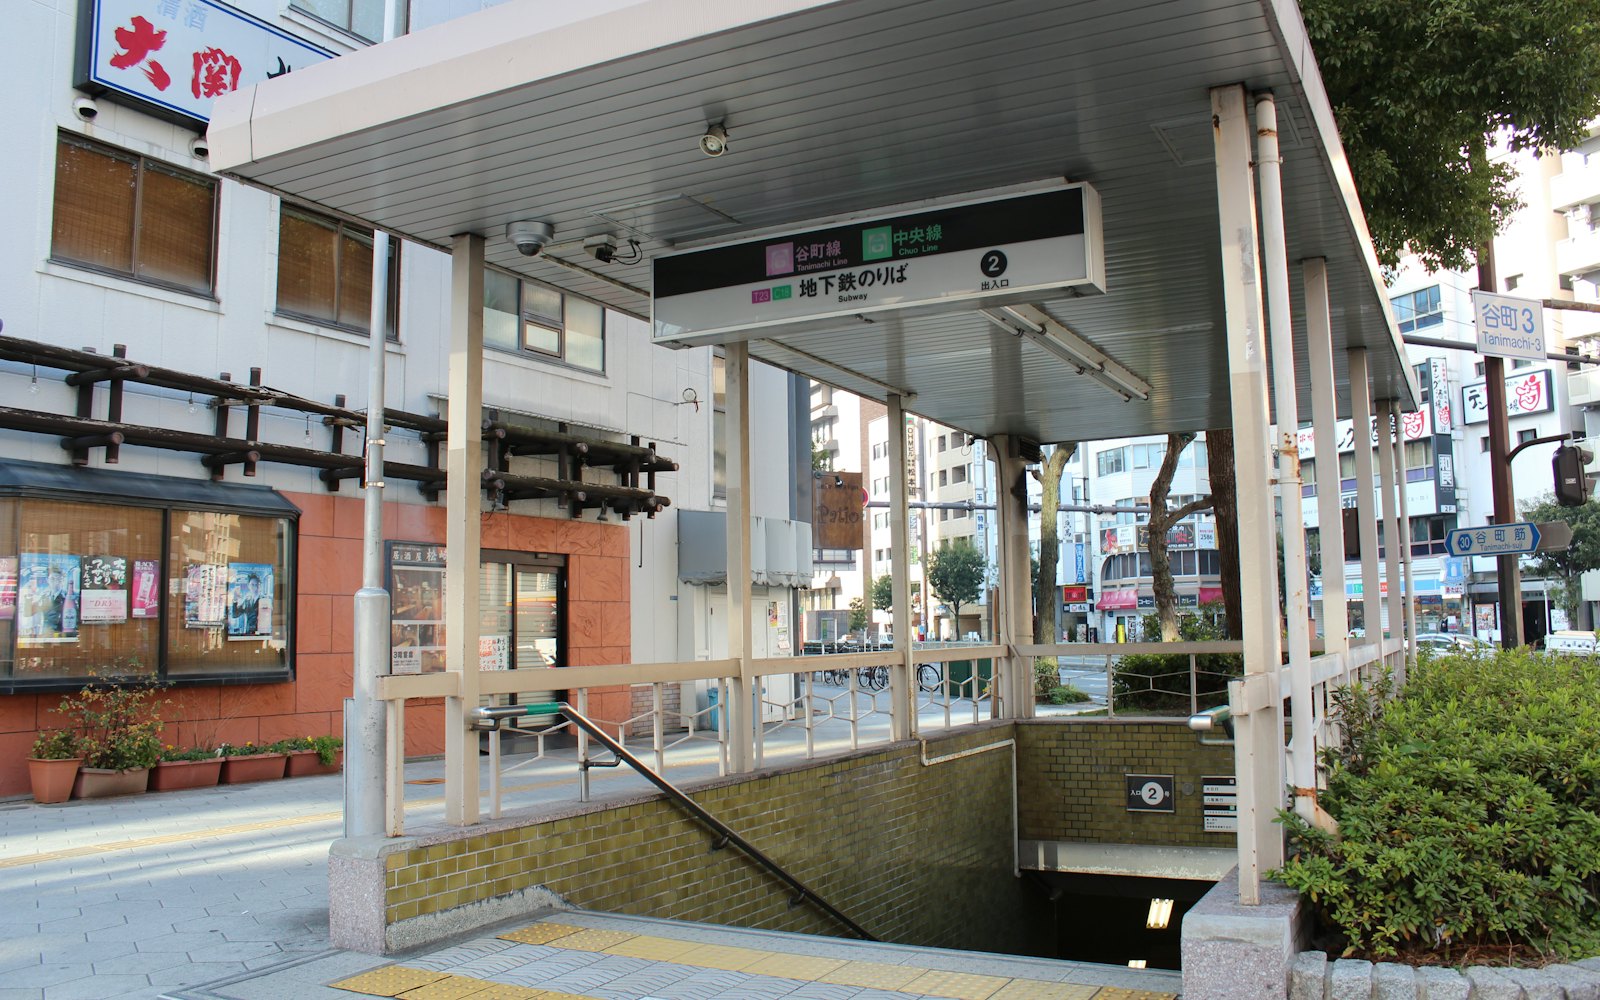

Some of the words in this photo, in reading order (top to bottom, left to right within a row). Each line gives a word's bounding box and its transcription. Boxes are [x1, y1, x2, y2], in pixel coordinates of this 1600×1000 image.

[893, 224, 943, 246] 中央線
[795, 240, 842, 262] 谷町線
[898, 246, 919, 256] Chuo
[921, 243, 939, 253] Line
[796, 260, 831, 272] Tanimachi
[832, 257, 849, 267] Line
[988, 255, 1000, 272] 2
[753, 289, 770, 302] T23
[799, 262, 910, 298] 地下鉄のりば
[981, 279, 1009, 291] 出入口
[838, 291, 868, 304] Subway
[1481, 331, 1542, 352] Tanimachi-3
[818, 504, 860, 524] Patio
[1459, 536, 1470, 548] 30
[1475, 527, 1526, 545] 谷町筋
[1480, 542, 1523, 552] Tanimachi-suji
[1147, 787, 1157, 800] 2
